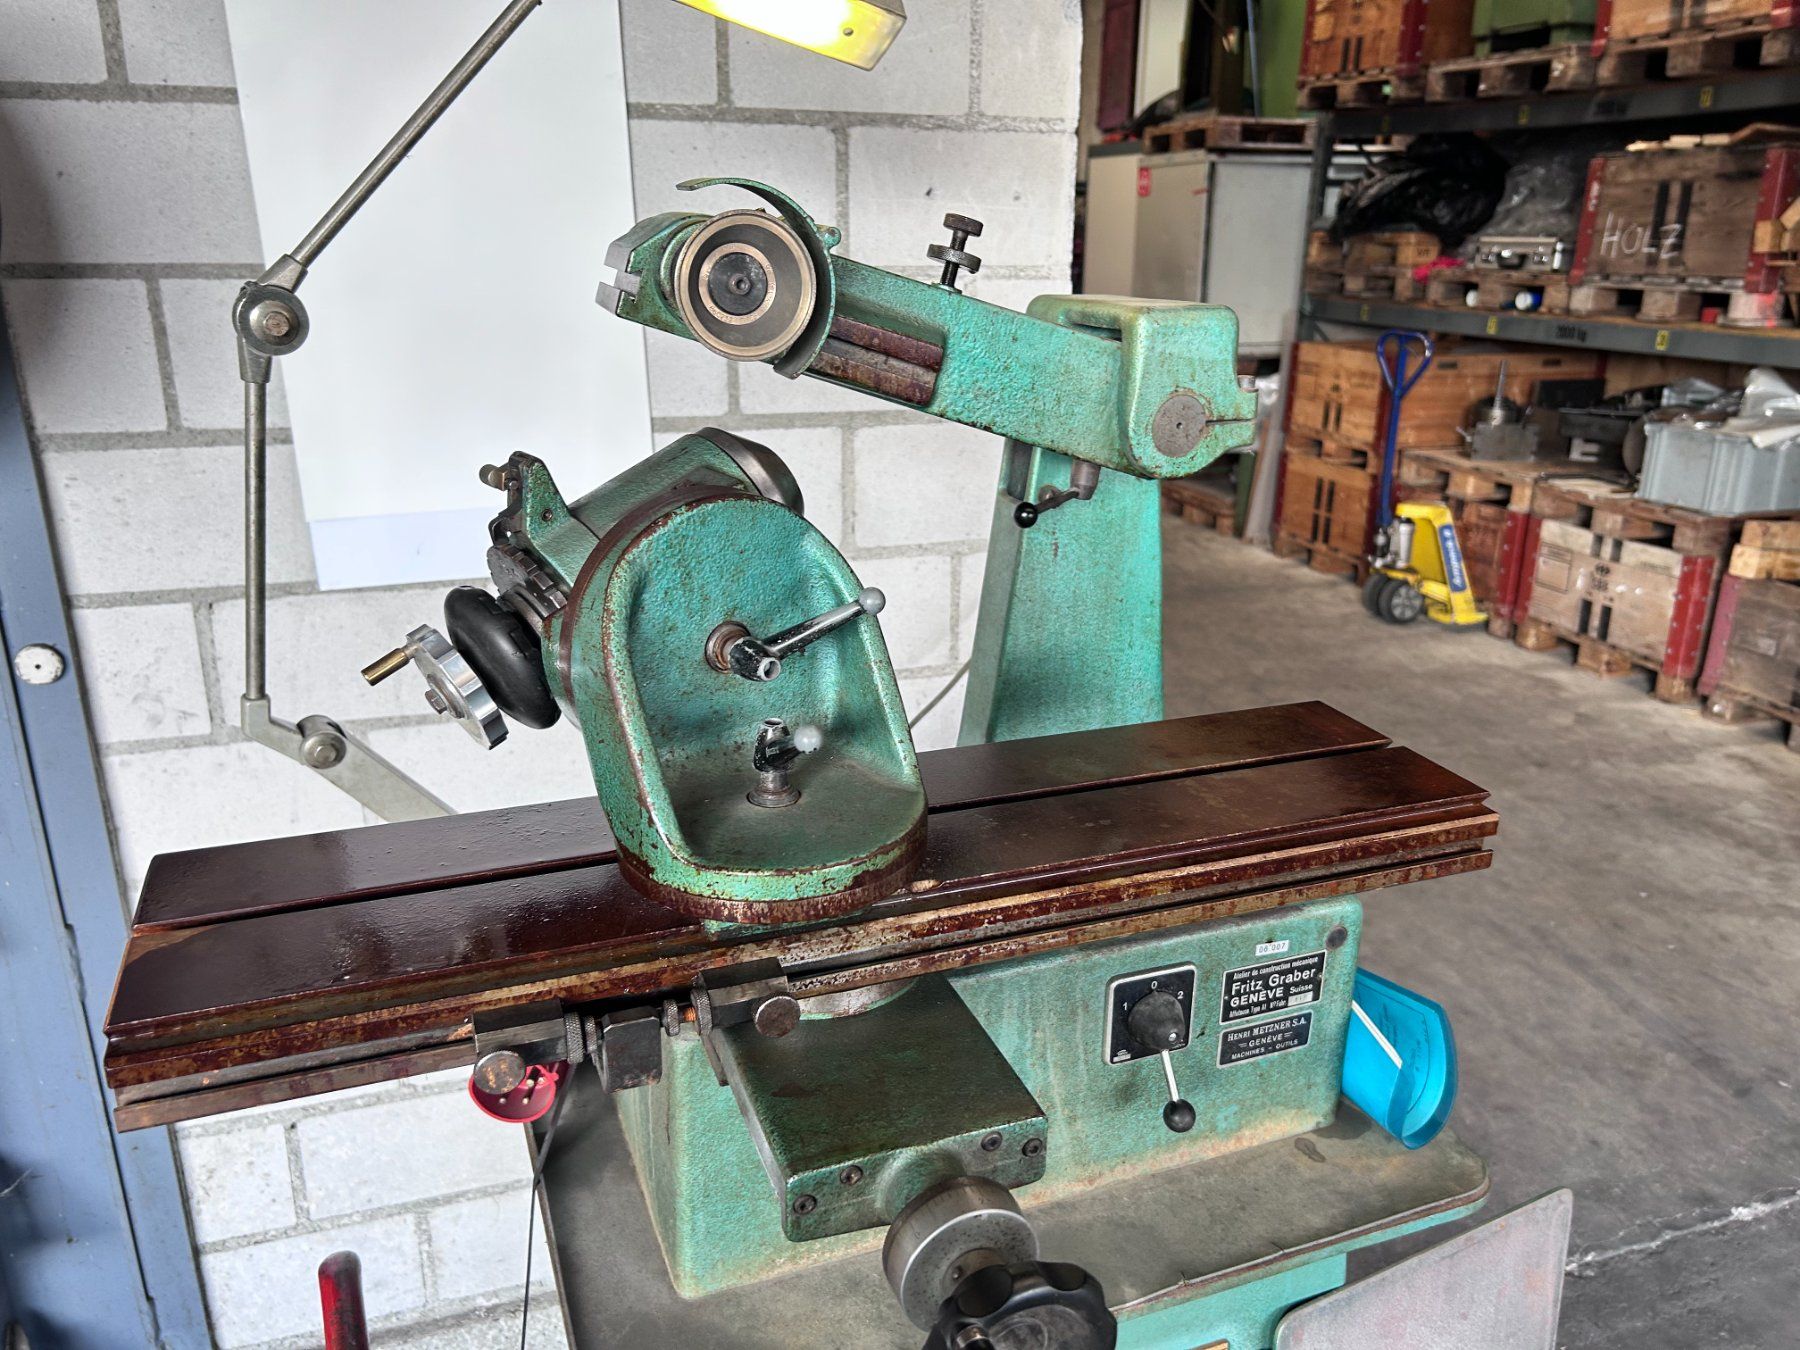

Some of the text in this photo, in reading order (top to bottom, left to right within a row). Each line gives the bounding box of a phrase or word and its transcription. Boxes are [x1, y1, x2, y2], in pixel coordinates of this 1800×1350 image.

[1600, 211, 1682, 259] HOLZ
[1233, 970, 1250, 980] Atelier
[1259, 962, 1291, 975] construction
[1151, 980, 1158, 989] 0
[1232, 968, 1316, 995] Fritz Graber
[1289, 983, 1313, 994] Suisse
[1177, 990, 1184, 999] 2
[1122, 1002, 1128, 1011] 1
[1228, 1016, 1307, 1042] HENRI METZNER S.A.
[1231, 1046, 1265, 1059] MACHINES
[1276, 1038, 1298, 1049] OUTILS
